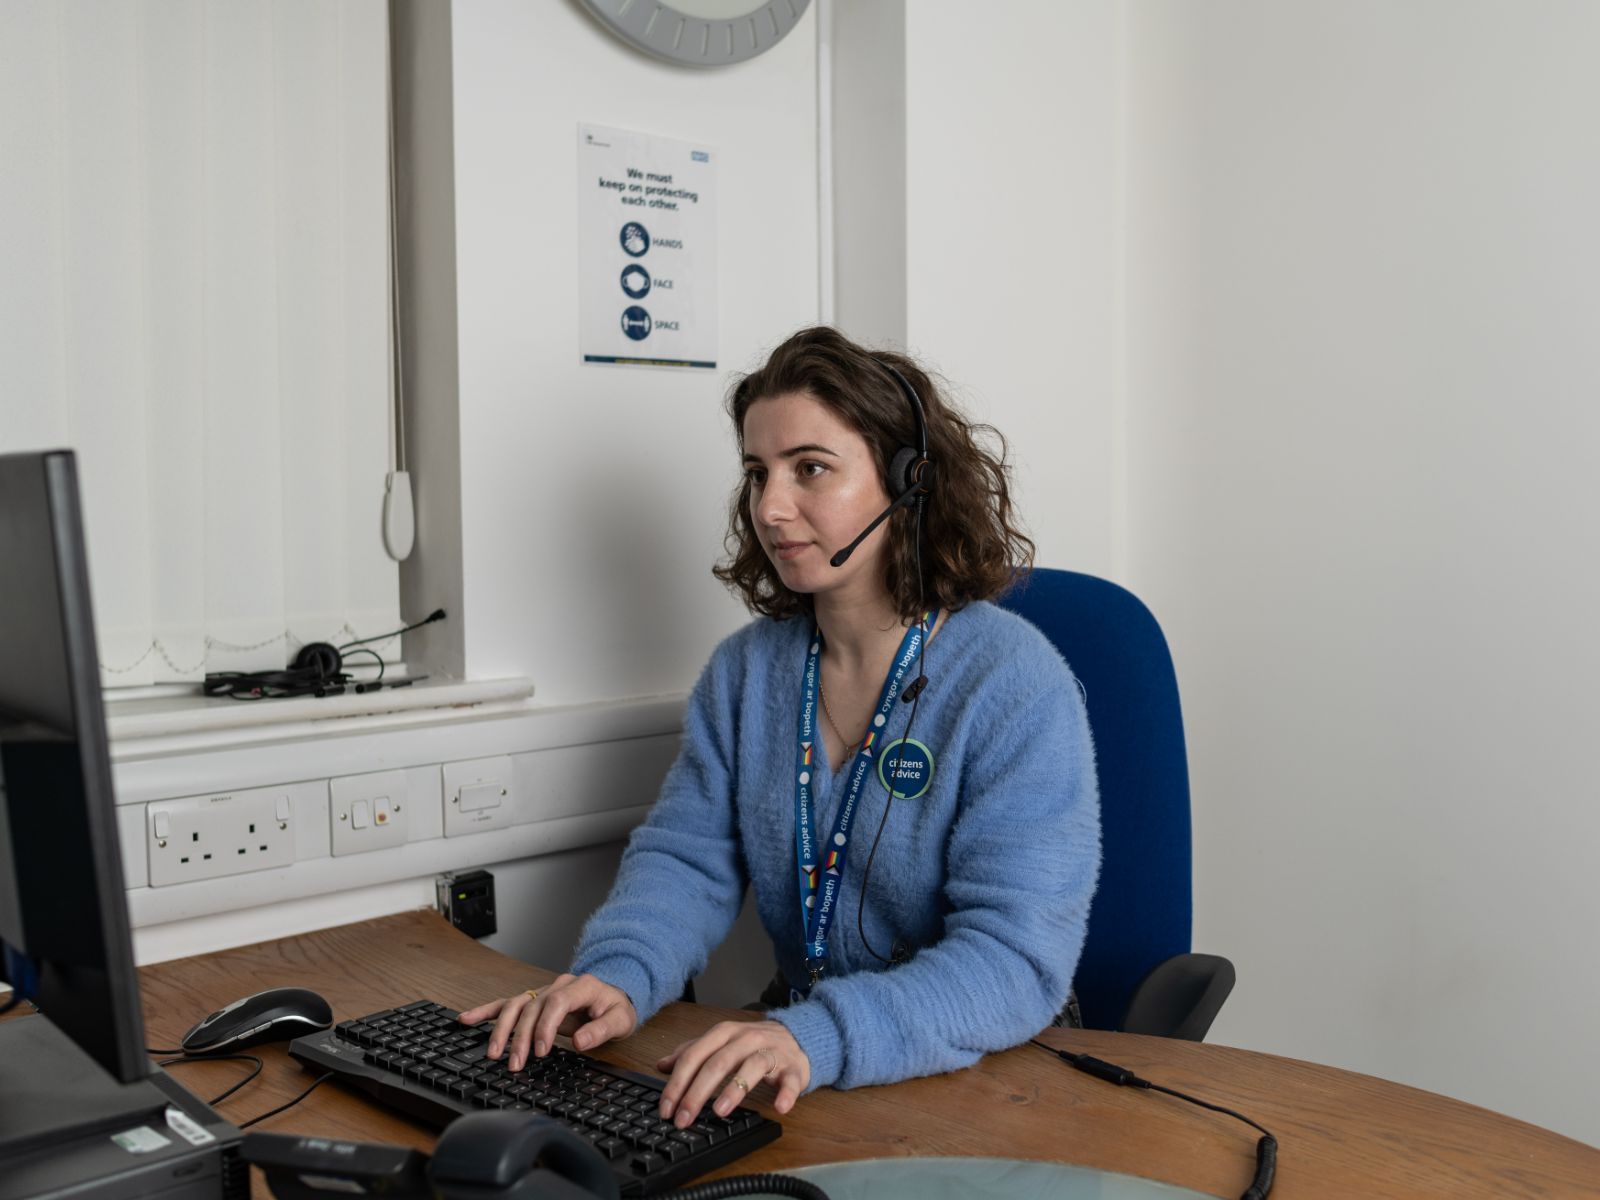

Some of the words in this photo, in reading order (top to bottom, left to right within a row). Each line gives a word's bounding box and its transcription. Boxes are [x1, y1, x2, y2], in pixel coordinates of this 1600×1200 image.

[627, 168, 643, 179] We
[646, 172, 673, 183] must
[599, 177, 626, 192] keep
[629, 183, 643, 192] on
[645, 185, 698, 203] protecting
[621, 195, 646, 207] each
[652, 238, 683, 250] HANDS
[653, 279, 673, 289] FACE
[654, 320, 680, 331] SPACE
[899, 634, 921, 668] bopeth
[806, 656, 816, 688] cyngor
[896, 668, 904, 679] ar
[807, 690, 814, 700] ar
[882, 679, 899, 712] cyngor
[803, 702, 814, 736] bopeth
[889, 758, 924, 769] ciizens
[800, 787, 809, 825] citizens
[840, 793, 856, 831] citizens
[852, 761, 867, 793] advice
[801, 826, 812, 859] advice
[820, 879, 836, 913] bopeth
[819, 914, 828, 924] ar
